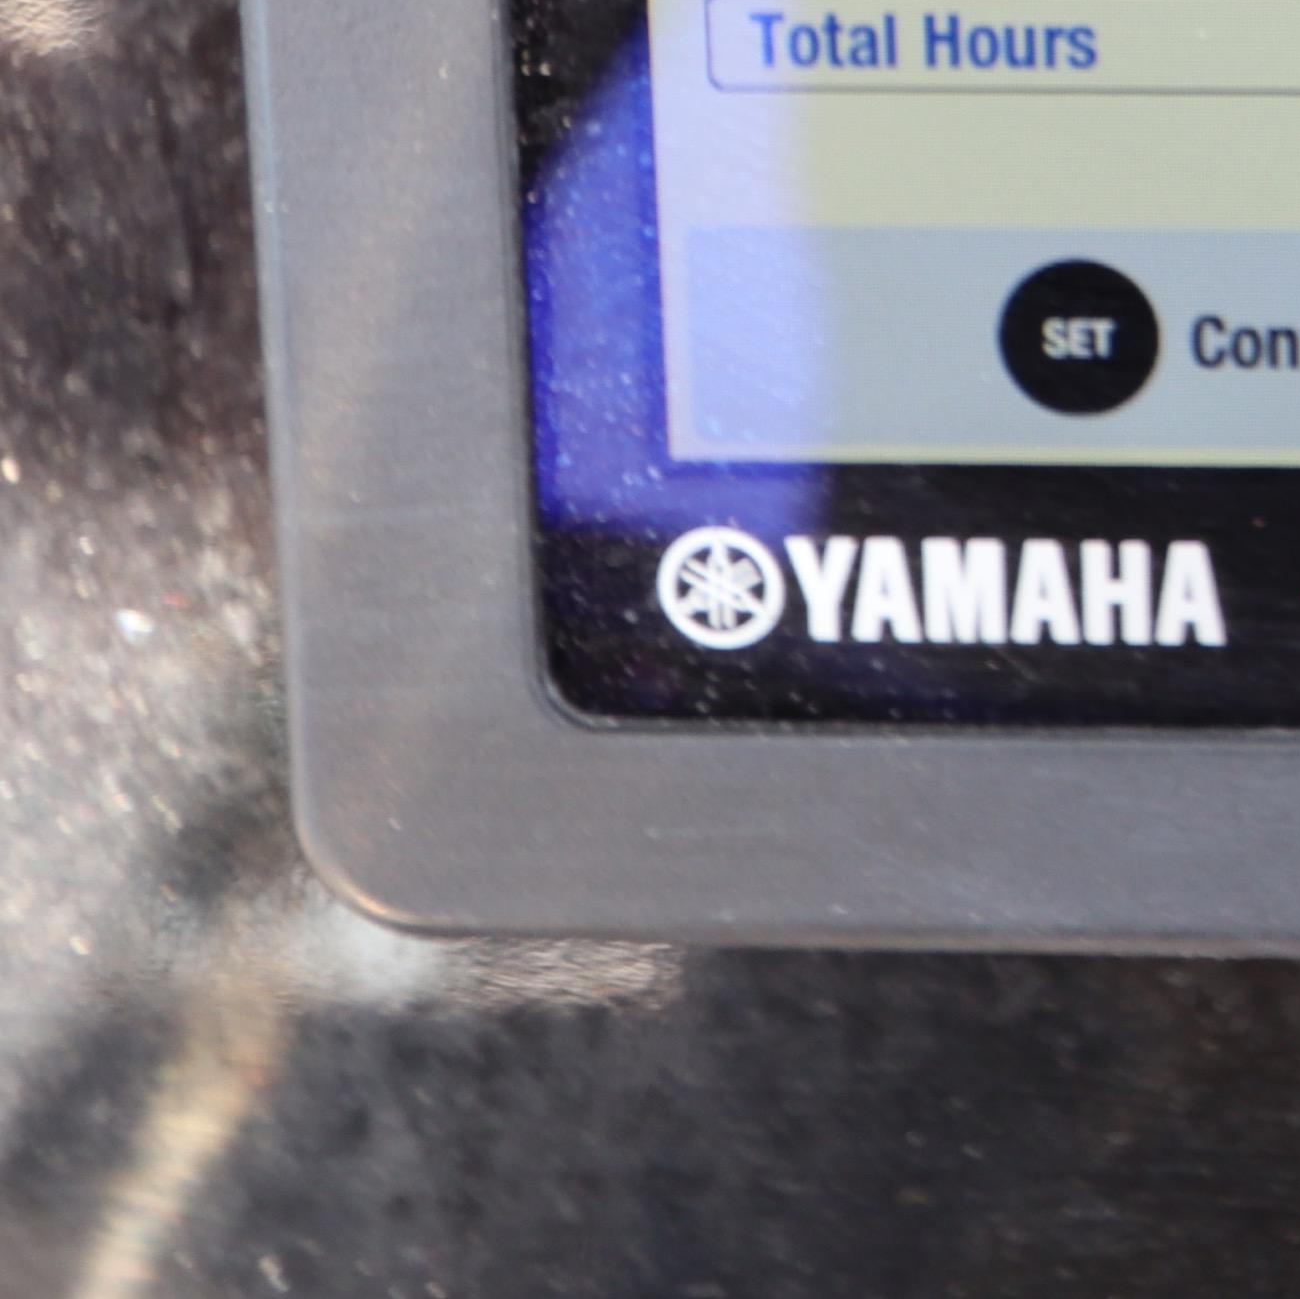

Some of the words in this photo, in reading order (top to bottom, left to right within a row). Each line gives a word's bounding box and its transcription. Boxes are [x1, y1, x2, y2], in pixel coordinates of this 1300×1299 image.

[750, 13, 896, 69] Total
[923, 13, 1098, 70] Hours
[1041, 317, 1117, 359] SET
[784, 535, 1226, 648] YAMAHA
